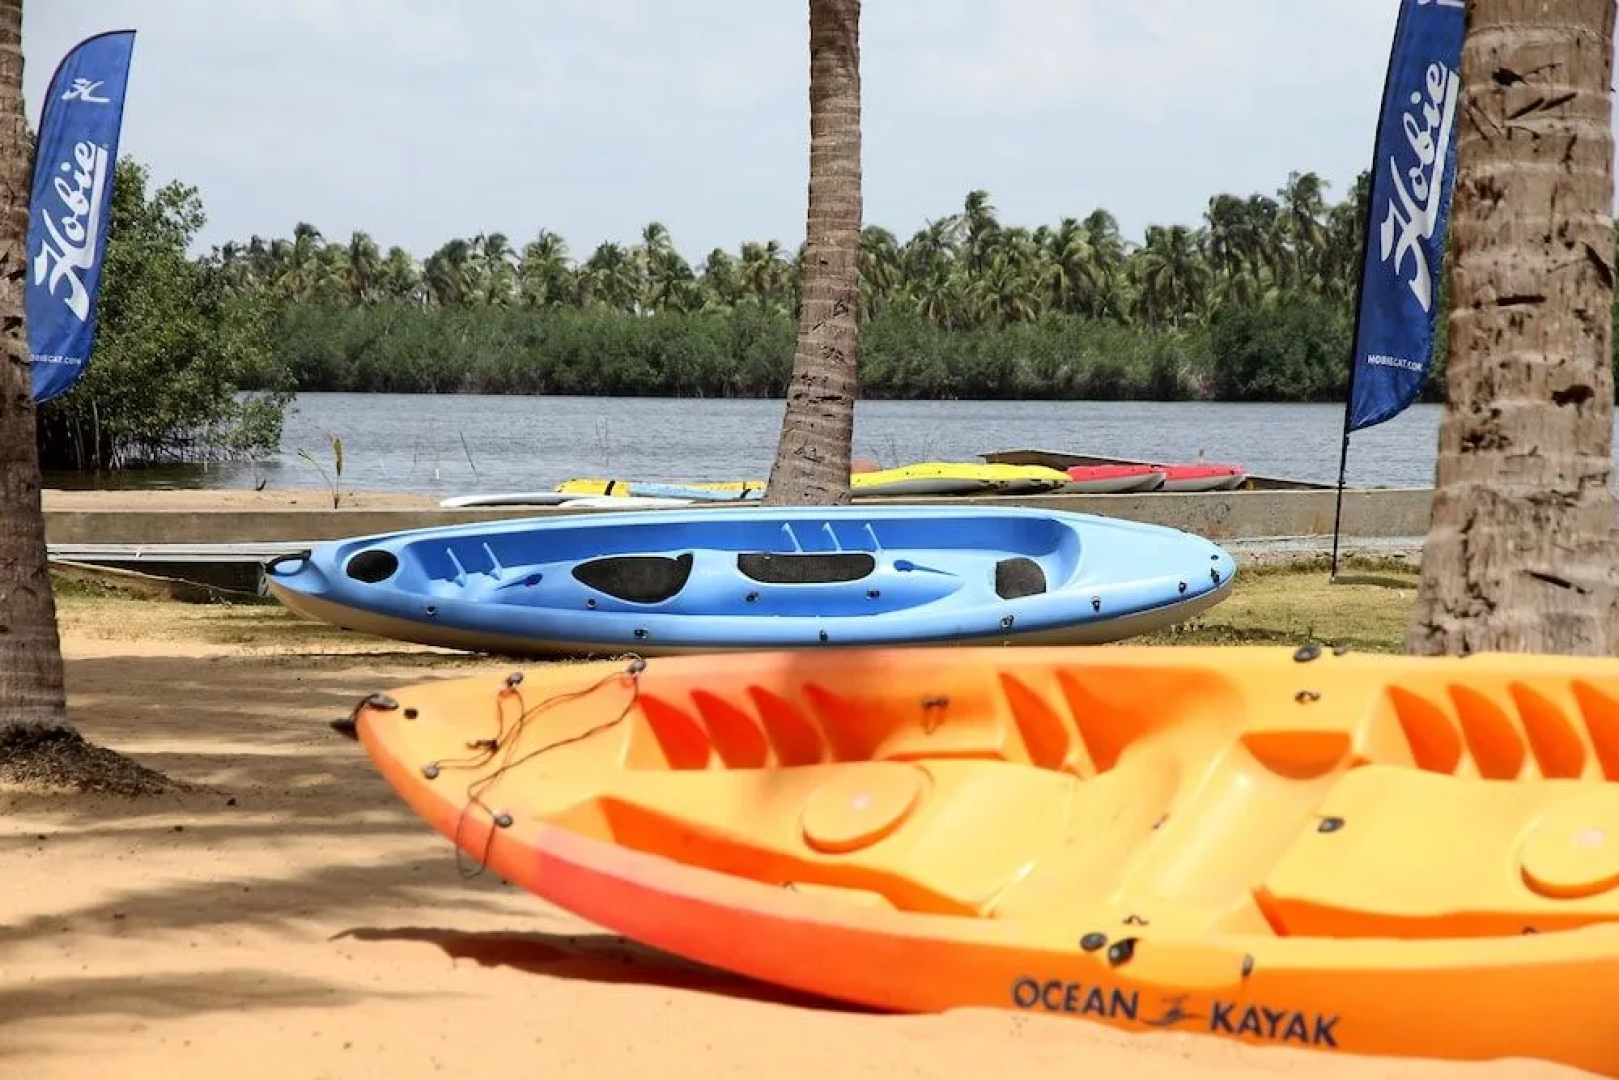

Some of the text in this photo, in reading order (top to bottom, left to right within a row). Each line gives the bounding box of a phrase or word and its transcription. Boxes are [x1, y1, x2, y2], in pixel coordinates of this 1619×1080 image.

[1381, 61, 1459, 313] Hobie
[35, 141, 107, 322] Hobie
[29, 353, 82, 365] OBIECAT.COM
[1367, 354, 1423, 372] HOBIECAT.COM
[1012, 976, 1340, 1048] OCEAN KAYAK
